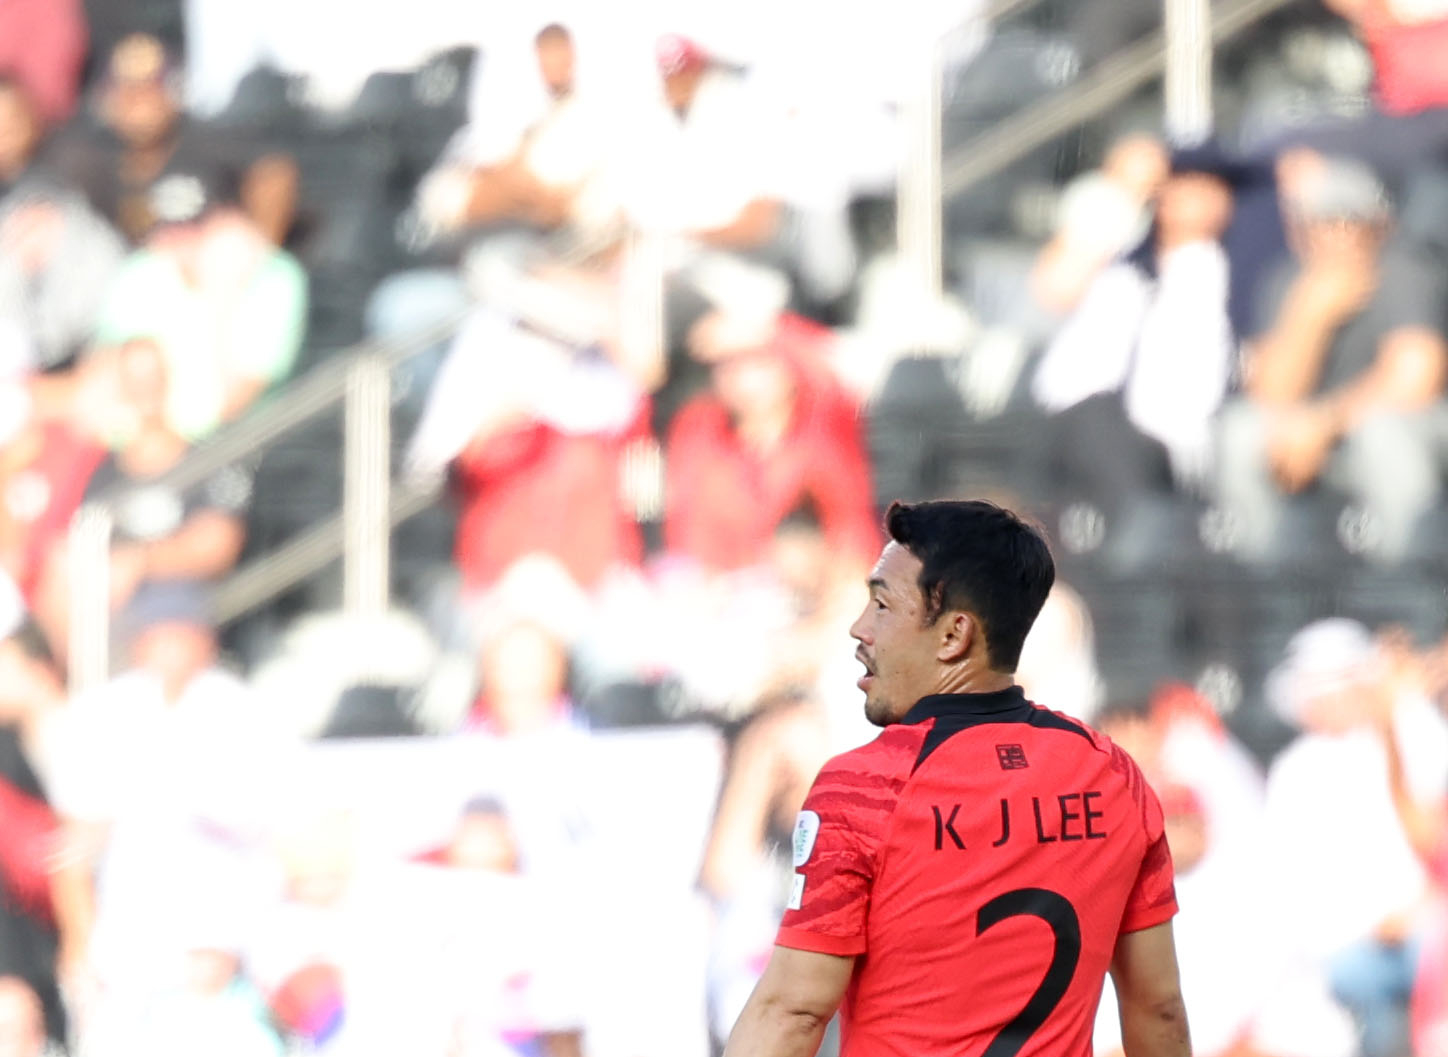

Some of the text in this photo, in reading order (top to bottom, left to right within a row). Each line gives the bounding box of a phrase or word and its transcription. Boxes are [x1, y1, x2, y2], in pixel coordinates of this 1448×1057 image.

[931, 791, 1108, 850] K J LEE
